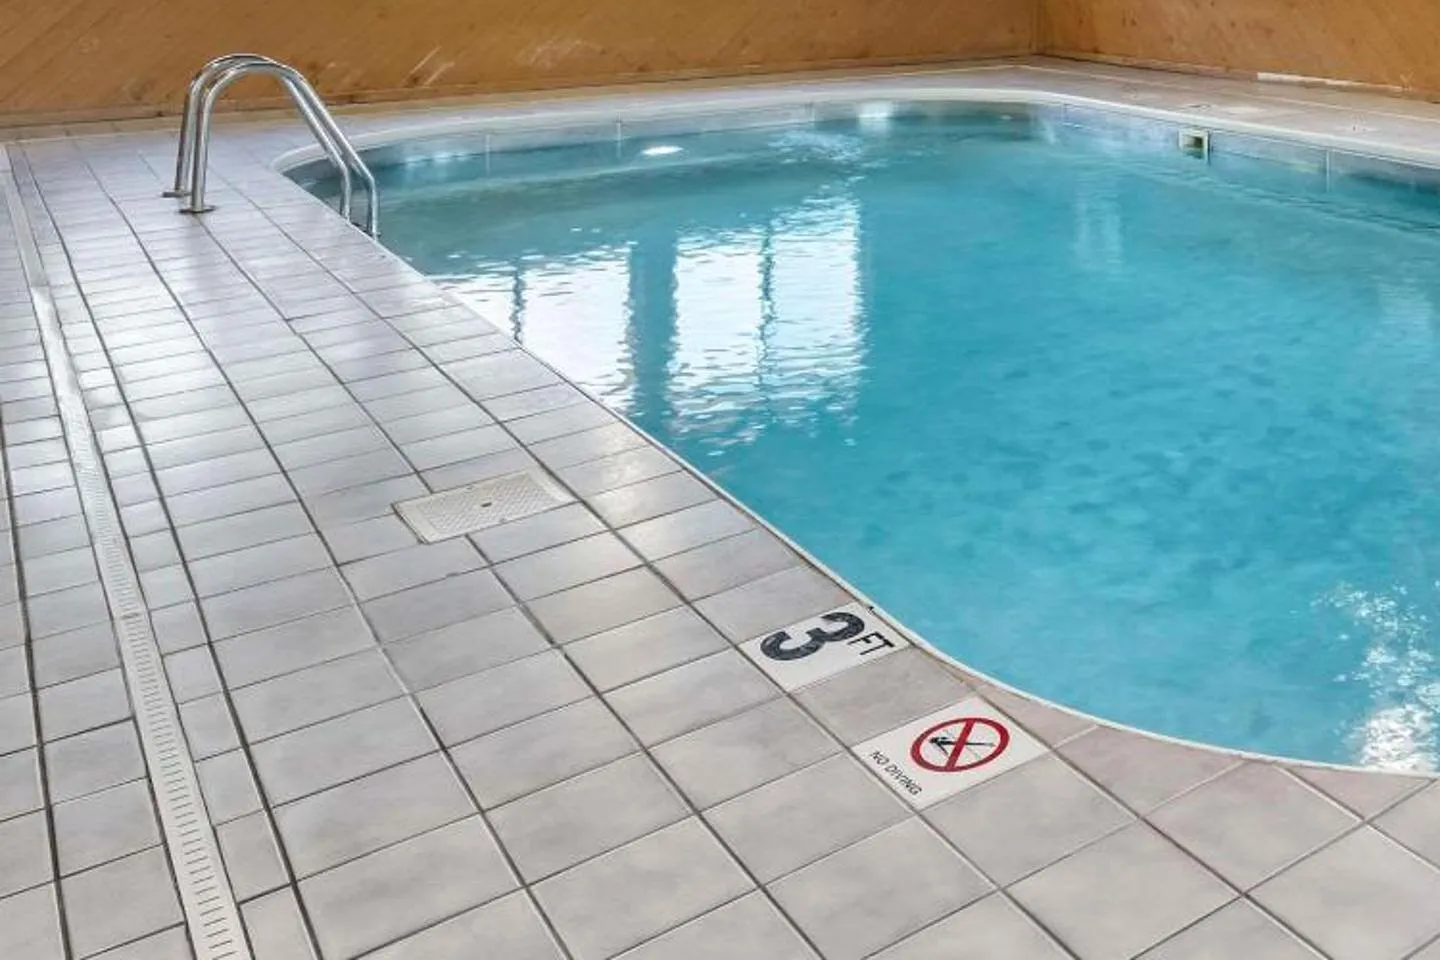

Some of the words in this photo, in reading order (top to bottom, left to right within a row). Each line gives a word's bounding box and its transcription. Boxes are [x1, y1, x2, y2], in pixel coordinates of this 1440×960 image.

[760, 612, 865, 661] 3
[848, 631, 895, 656] FT
[869, 751, 890, 765] NO
[884, 763, 923, 796] DIVING
